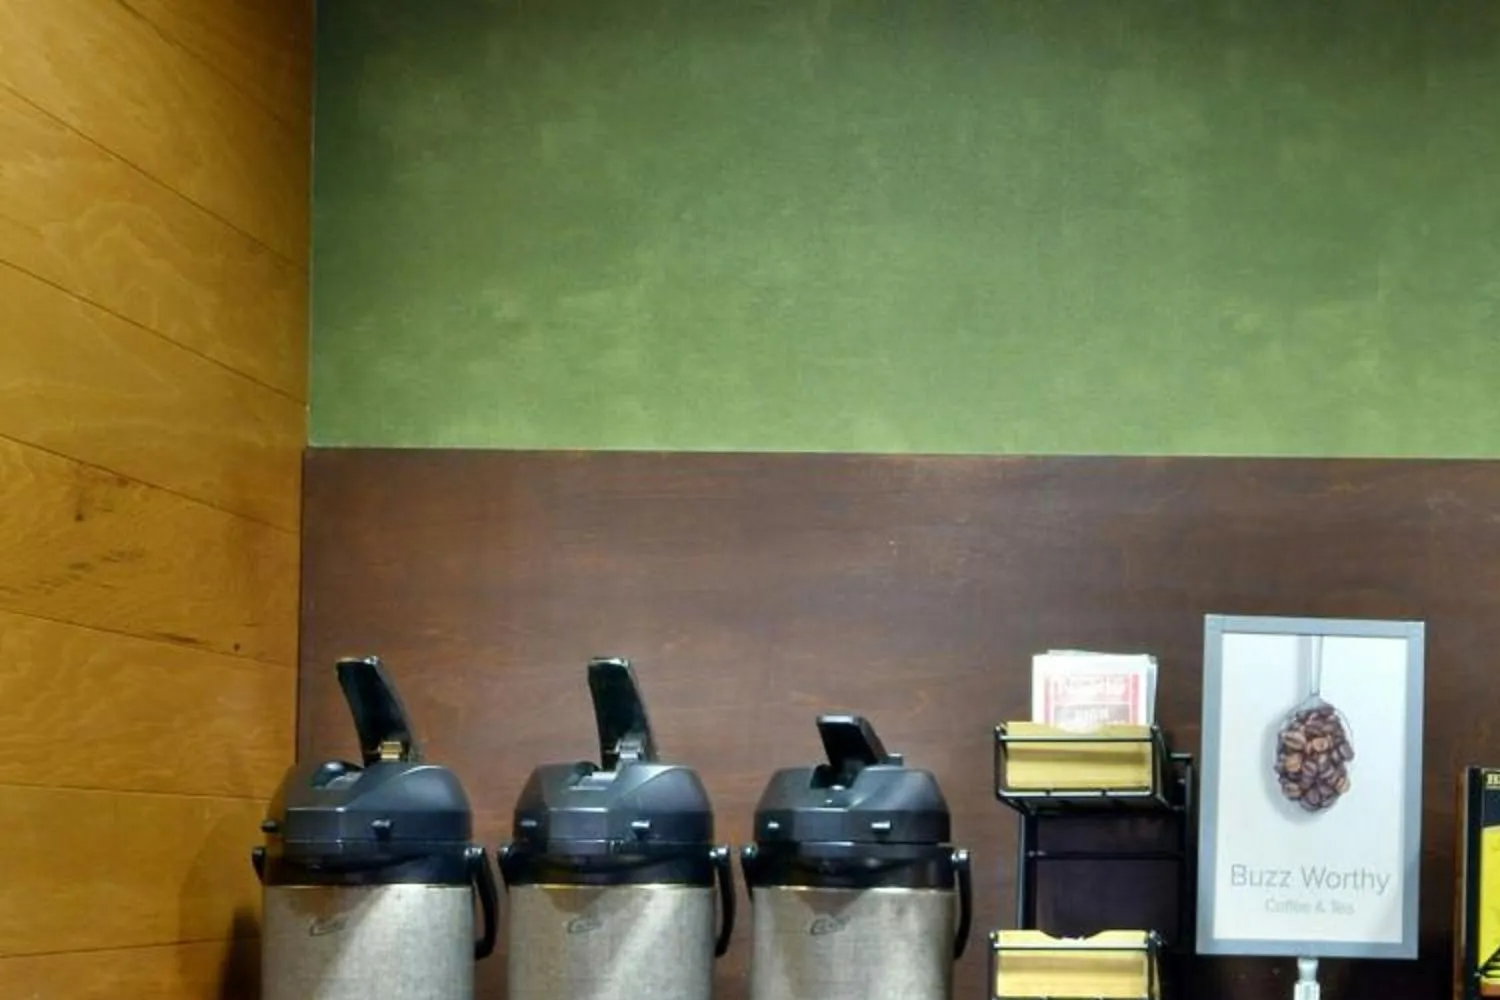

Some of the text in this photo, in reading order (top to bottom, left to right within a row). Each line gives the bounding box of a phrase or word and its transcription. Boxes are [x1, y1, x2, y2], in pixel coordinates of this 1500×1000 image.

[1231, 863, 1391, 896] Buzz Worthy
[1265, 898, 1311, 914] Coffee
